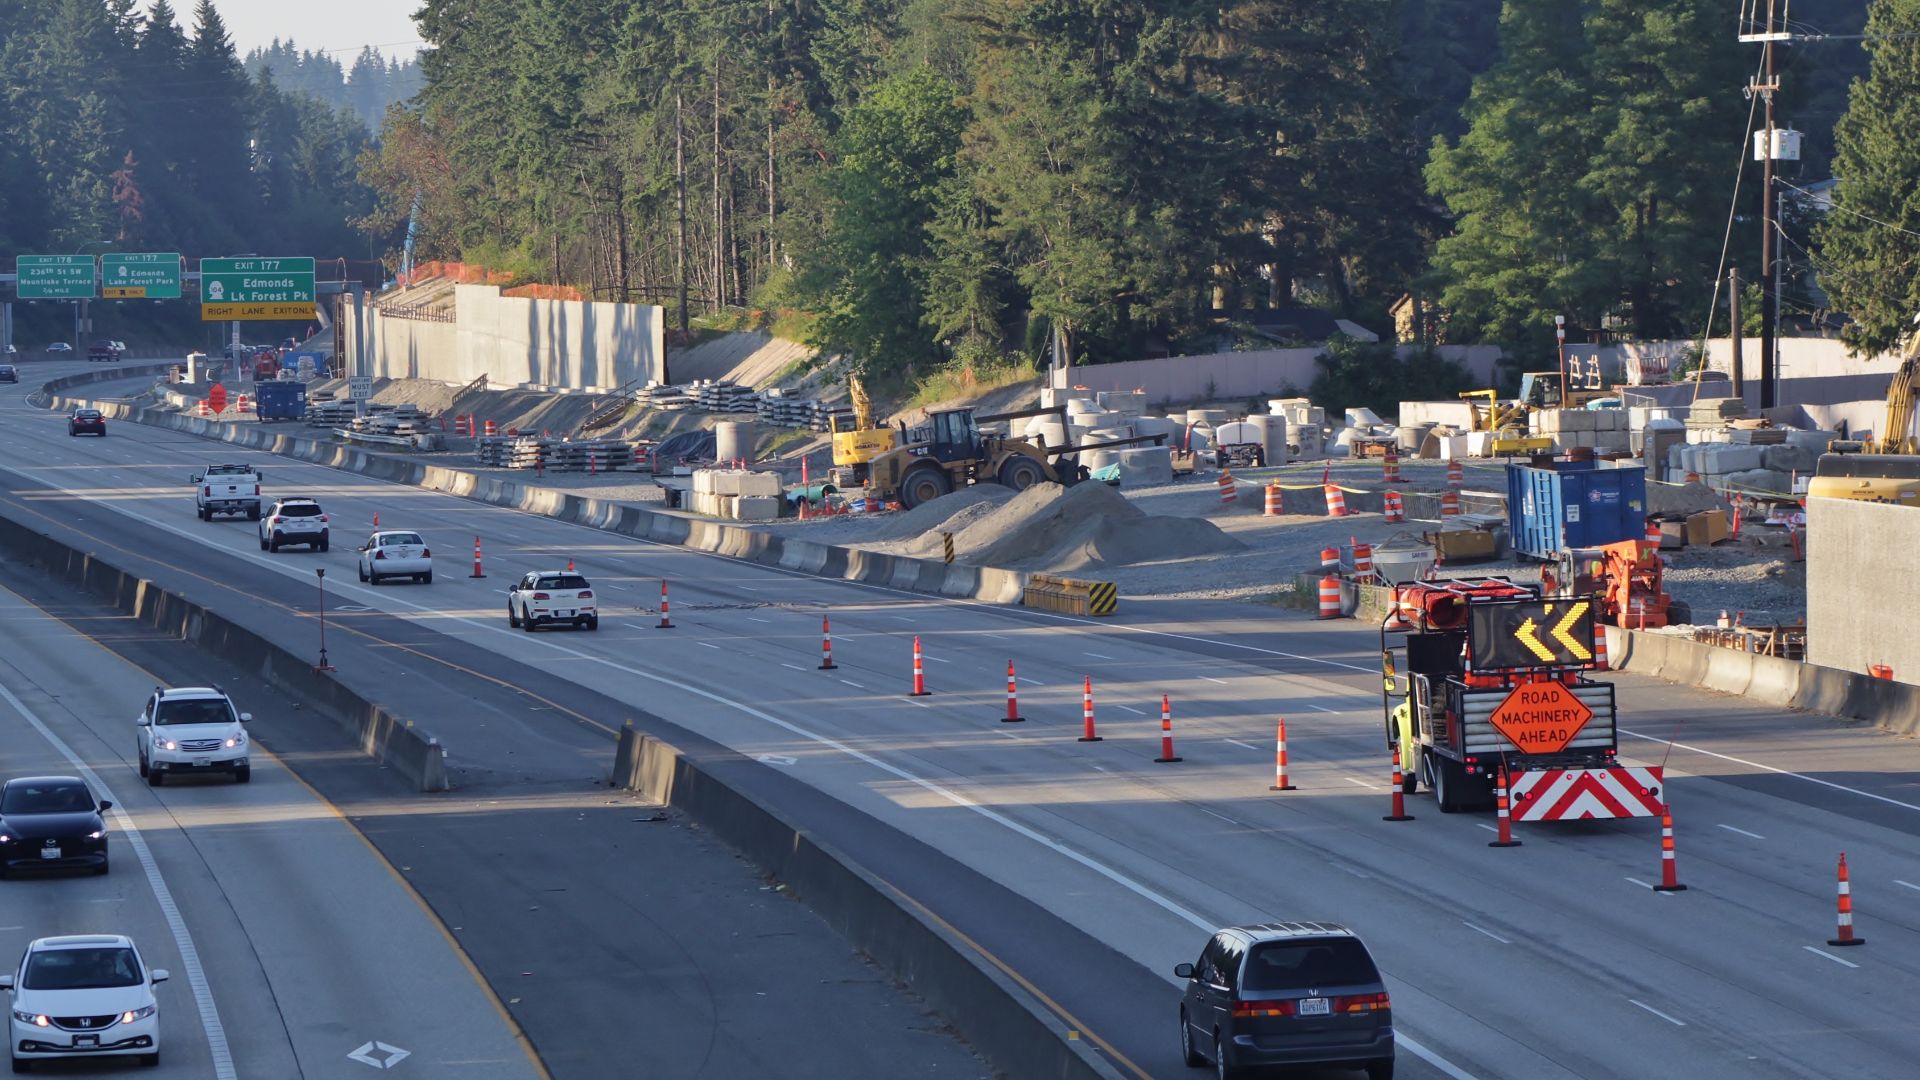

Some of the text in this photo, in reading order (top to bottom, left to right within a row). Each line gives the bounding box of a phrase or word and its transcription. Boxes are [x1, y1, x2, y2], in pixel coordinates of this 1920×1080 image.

[57, 256, 72, 264] 178
[260, 261, 280, 270] 177
[243, 278, 294, 288] Edmonds
[231, 291, 308, 301] Lk Forest Pk
[208, 307, 233, 315] RIGHT
[241, 307, 265, 315] LANE
[1521, 690, 1560, 705] ROAD
[1501, 709, 1580, 725] MACHINERY
[1518, 729, 1568, 744] AHEAD
